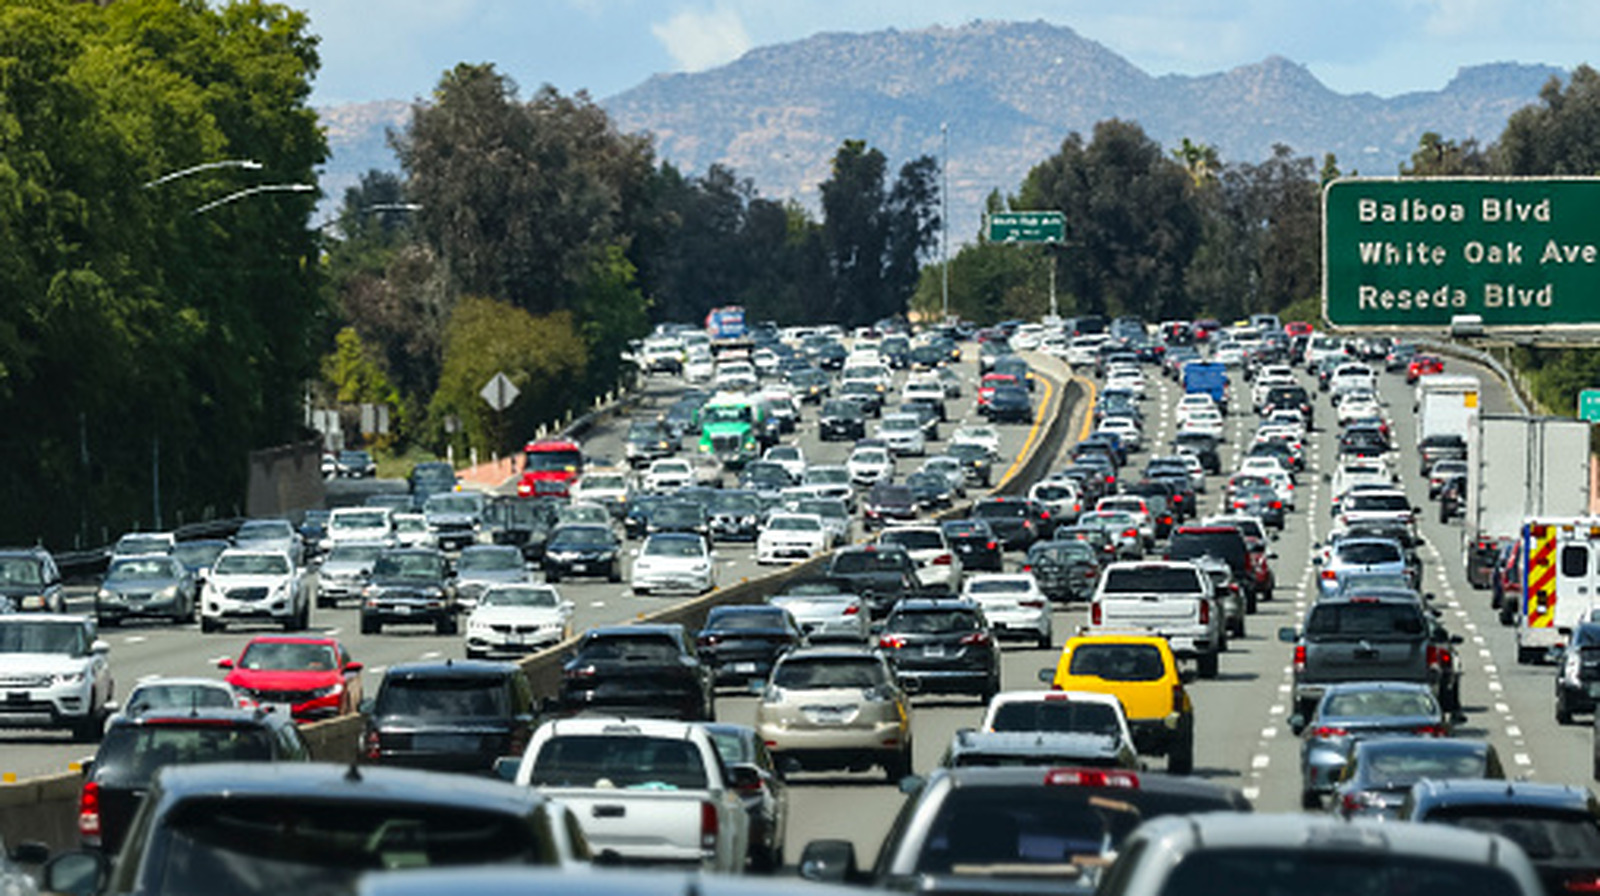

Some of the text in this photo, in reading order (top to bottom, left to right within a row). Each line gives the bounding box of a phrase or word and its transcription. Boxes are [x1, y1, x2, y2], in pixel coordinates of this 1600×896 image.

[1358, 198, 1551, 222] Balboa Blvd
[1358, 239, 1597, 265] White Oak Ave
[1358, 283, 1553, 310] Reseda Blvd
